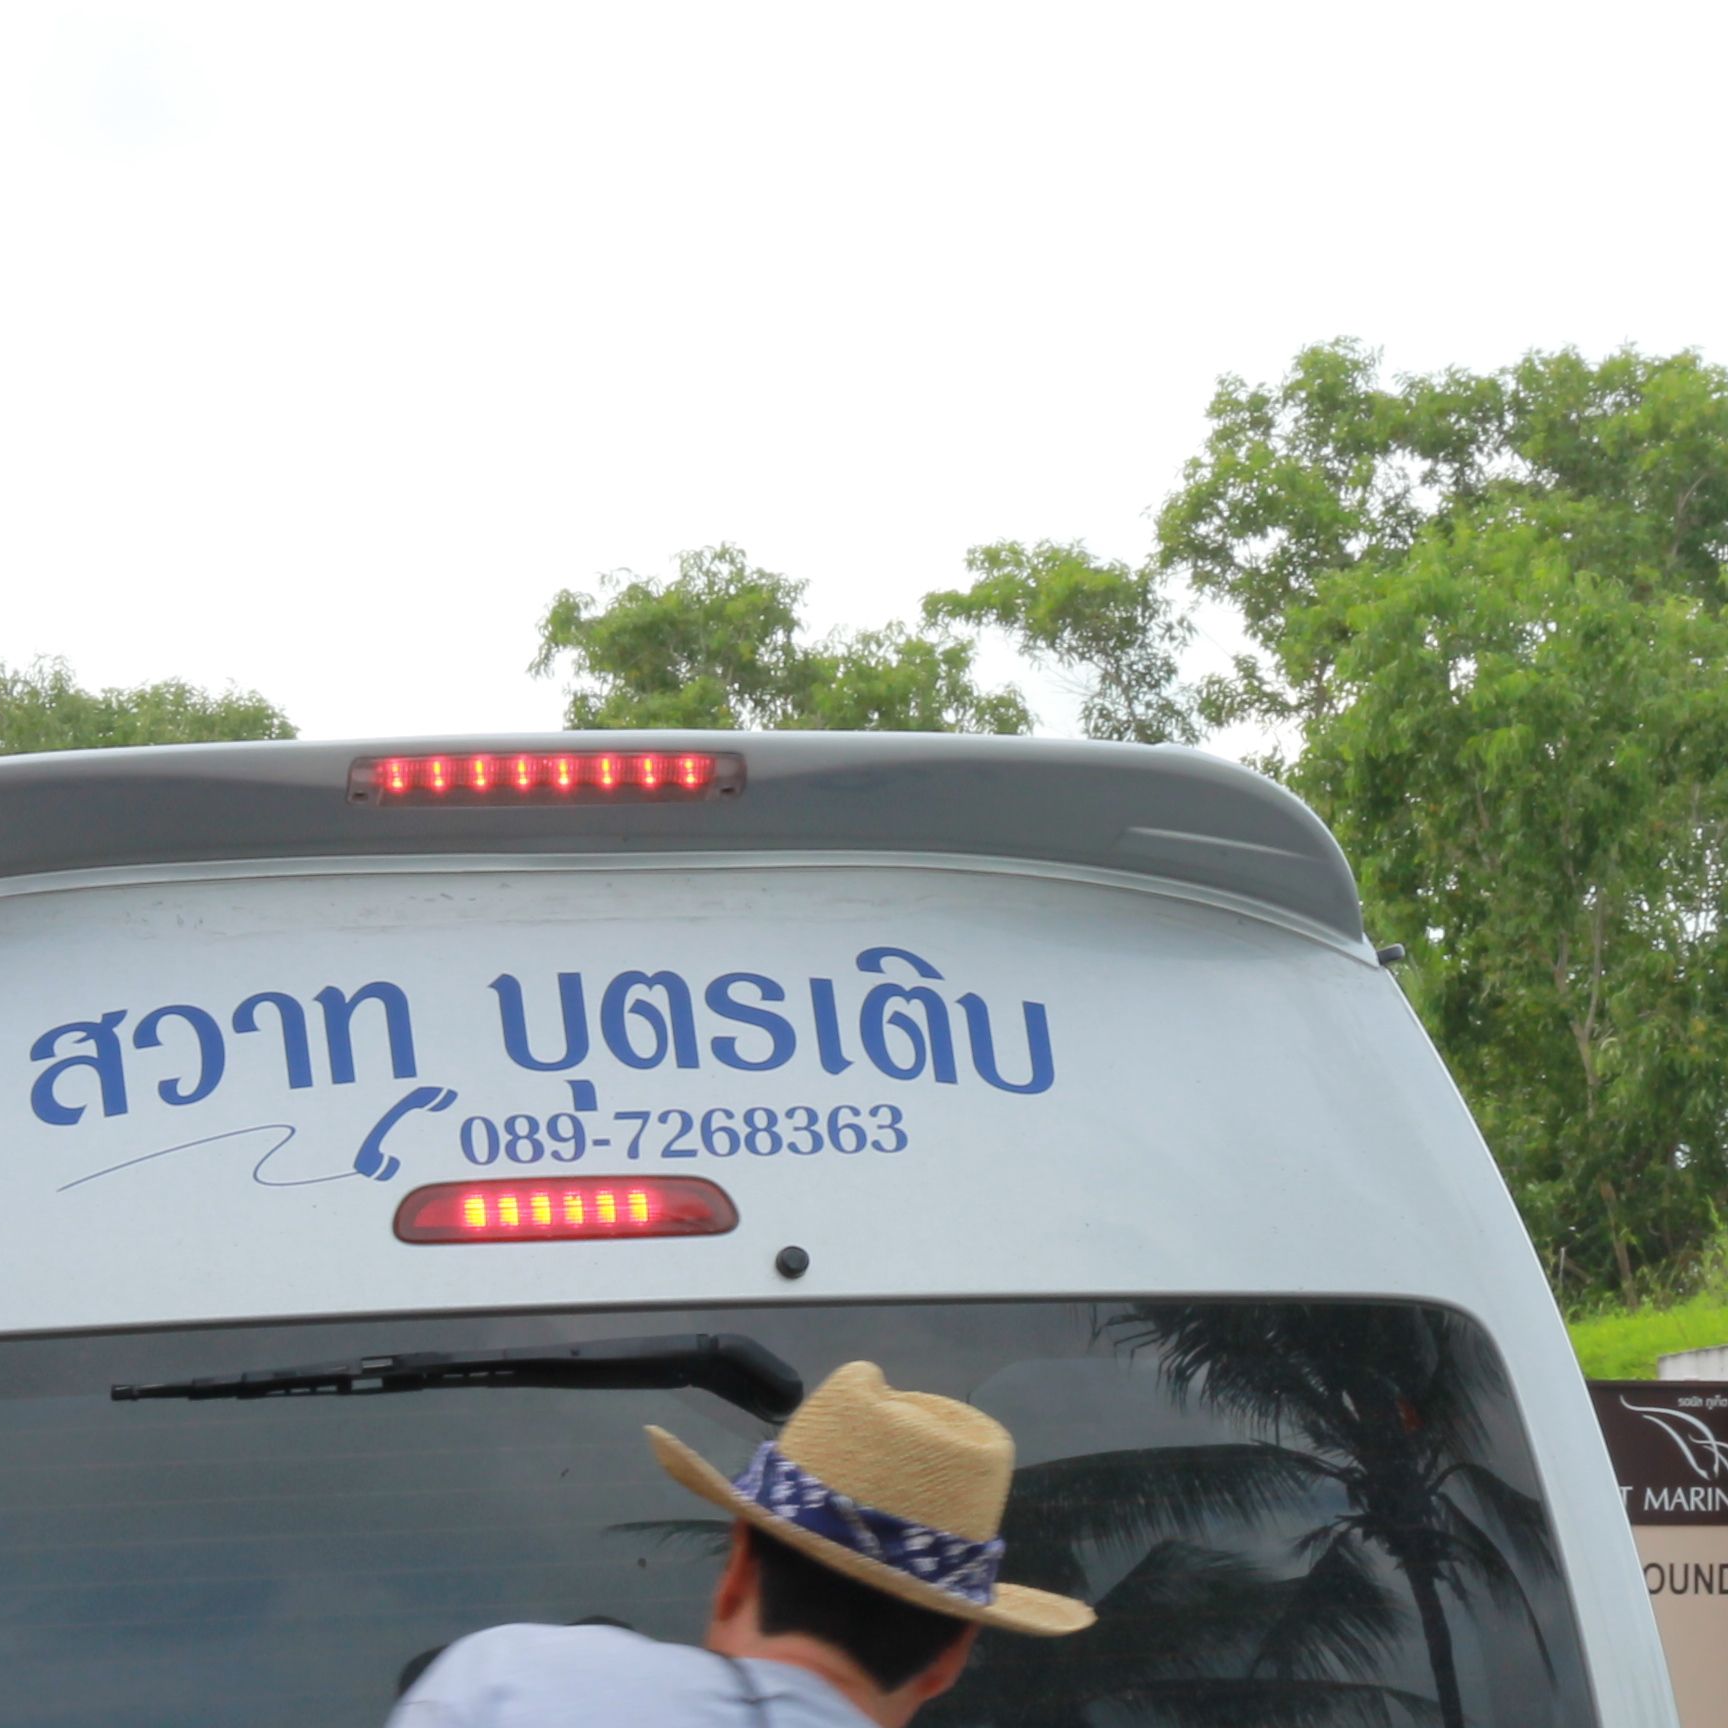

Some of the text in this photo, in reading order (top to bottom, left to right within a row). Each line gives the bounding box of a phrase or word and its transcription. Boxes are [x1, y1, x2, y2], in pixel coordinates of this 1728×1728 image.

[29, 946, 1057, 1127] สวาท บุตรเติบ
[459, 1103, 910, 1167] 089-7268363
